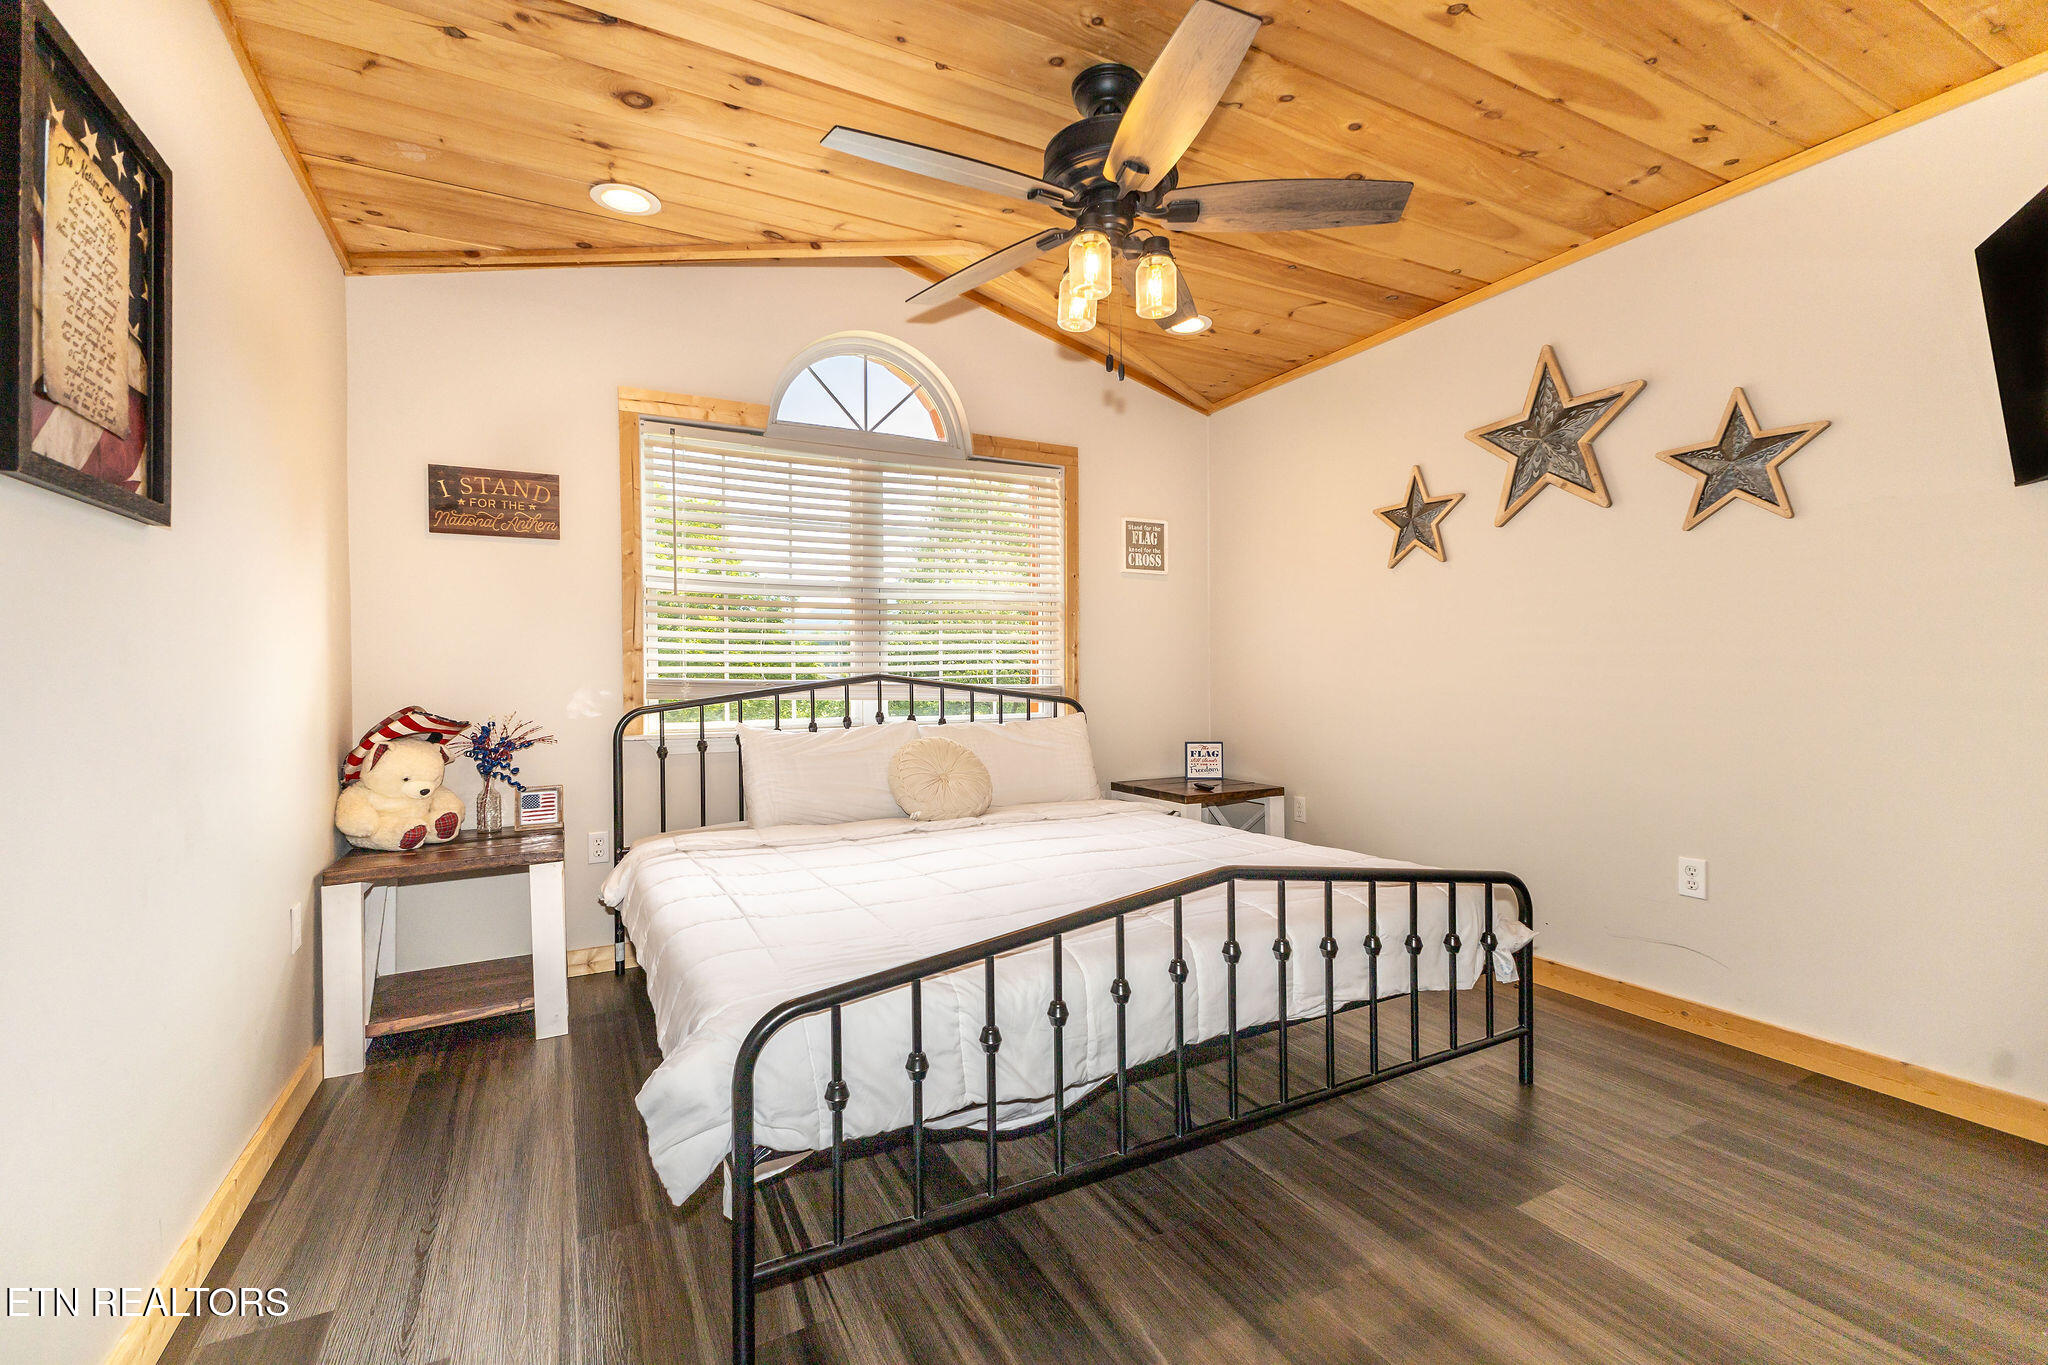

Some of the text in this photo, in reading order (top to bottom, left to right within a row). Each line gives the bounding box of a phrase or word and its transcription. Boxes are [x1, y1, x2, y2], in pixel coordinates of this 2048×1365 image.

[437, 476, 551, 504] I STAND
[469, 497, 525, 511] FOR THE
[433, 510, 557, 533] National Anthem
[1132, 530, 1158, 545] FLAG
[1128, 552, 1162, 567] CROSS
